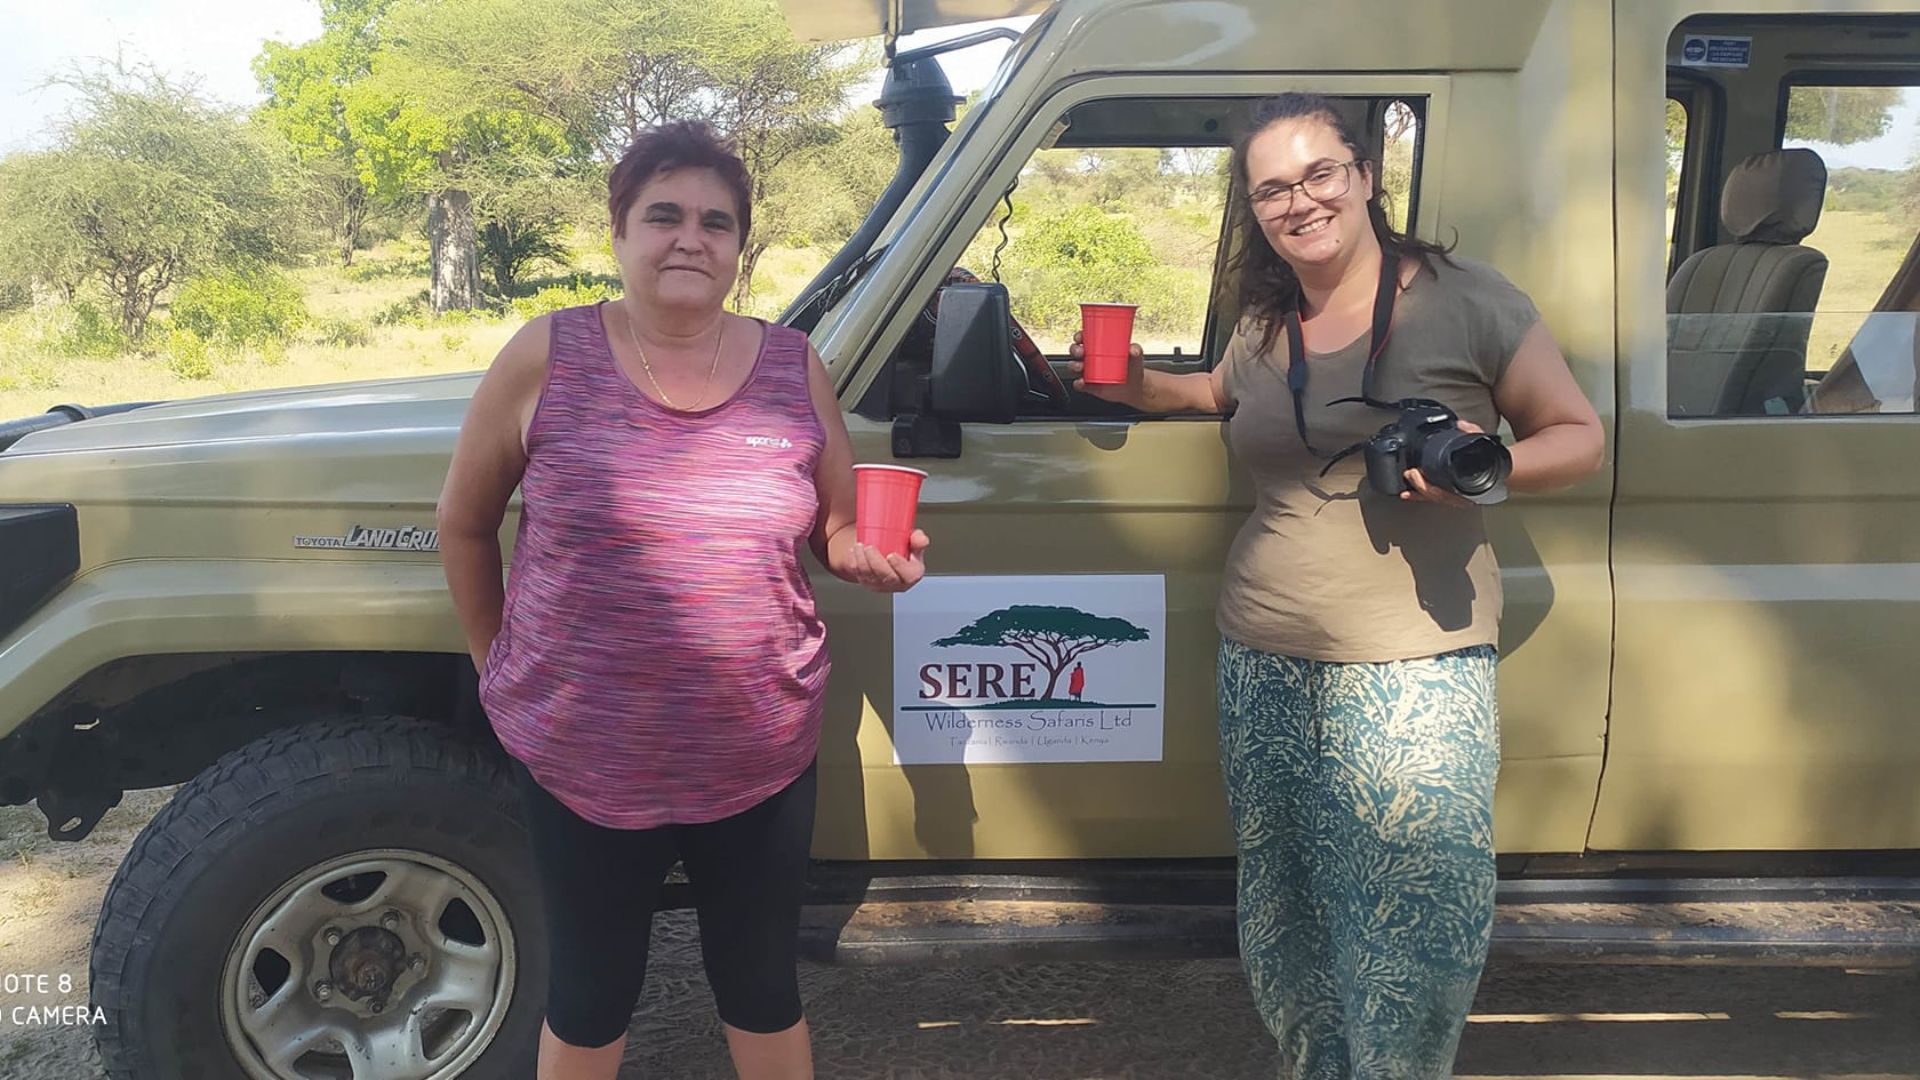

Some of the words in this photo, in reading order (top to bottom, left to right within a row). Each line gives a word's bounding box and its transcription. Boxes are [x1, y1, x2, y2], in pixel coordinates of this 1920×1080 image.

[296, 537, 340, 547] TOYOTA
[919, 663, 1036, 699] SERE
[925, 711, 1023, 732] Wilderness
[1027, 710, 1094, 731] Safaris
[1100, 709, 1132, 730] Ltd
